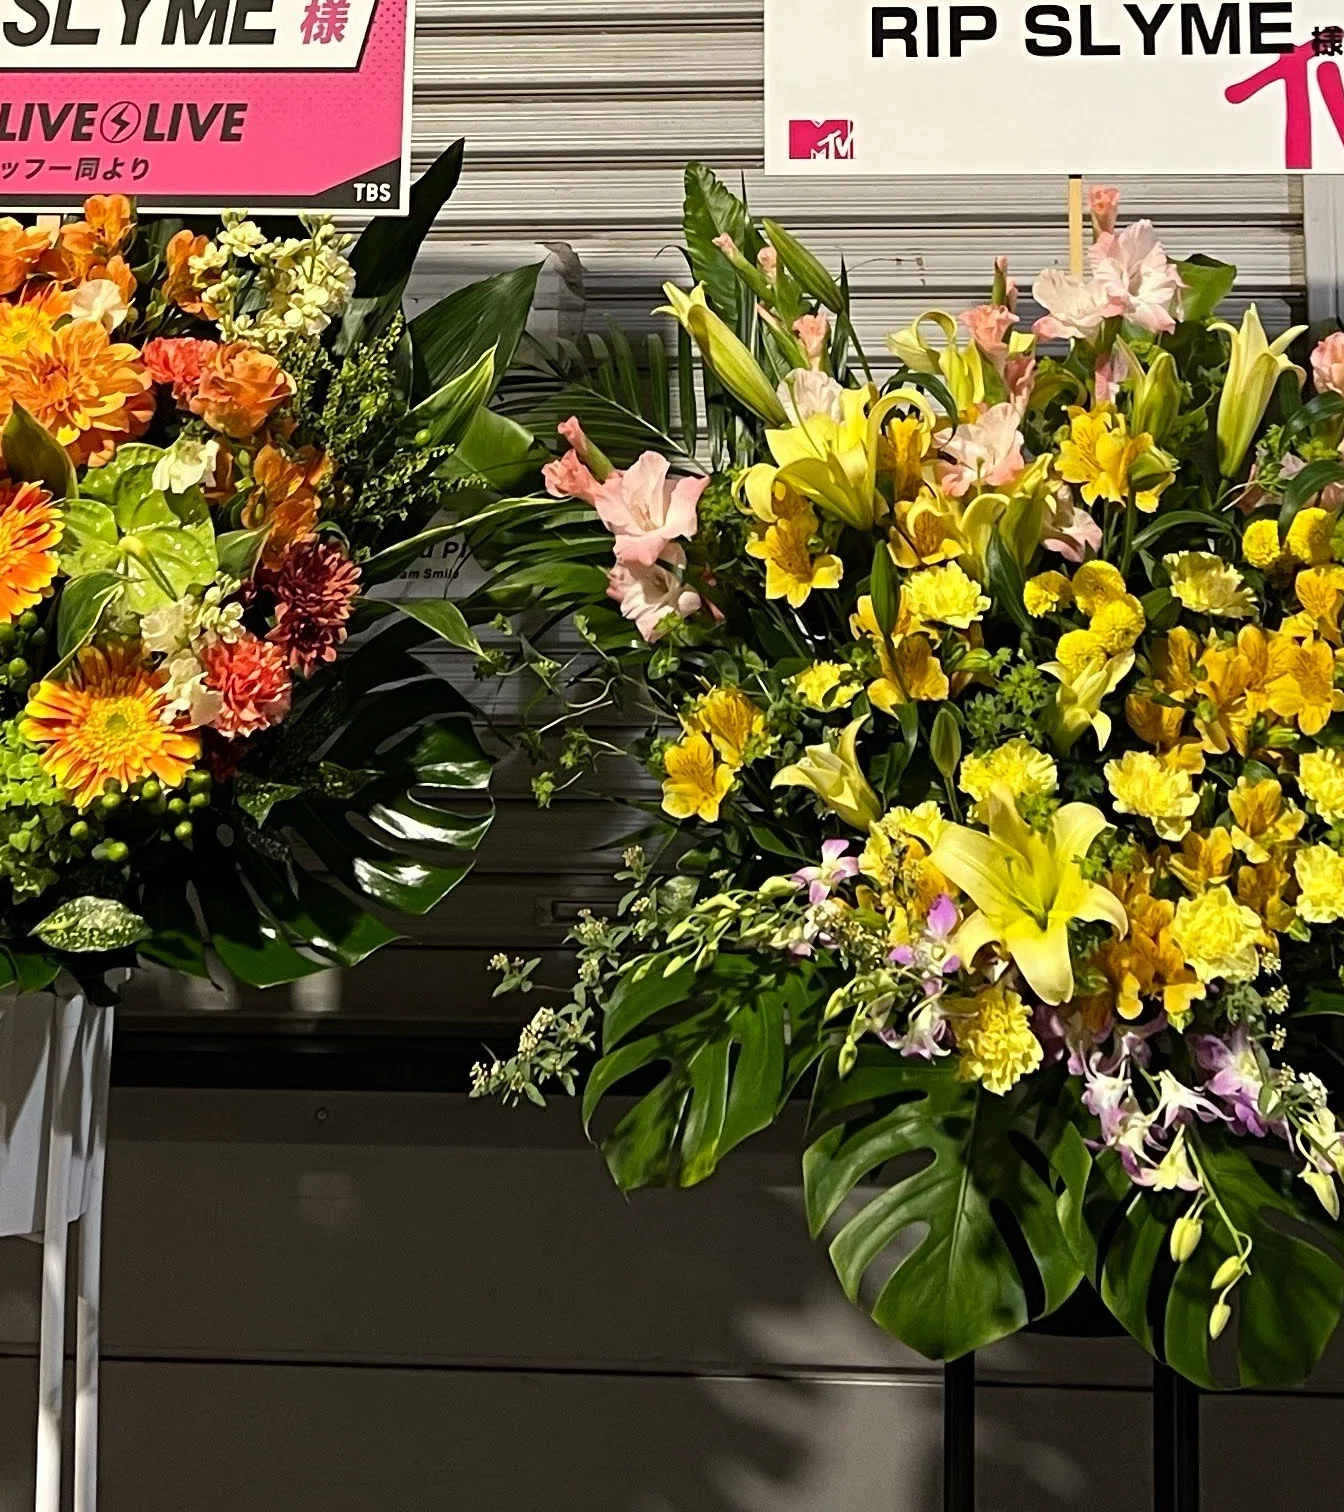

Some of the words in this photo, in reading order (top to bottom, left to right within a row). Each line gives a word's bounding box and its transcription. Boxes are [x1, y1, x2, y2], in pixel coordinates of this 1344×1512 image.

[870, 5, 999, 58] RIP
[1024, 1, 1294, 57] SLYME
[143, 102, 249, 141] LIVE
[353, 183, 392, 203] TBS
